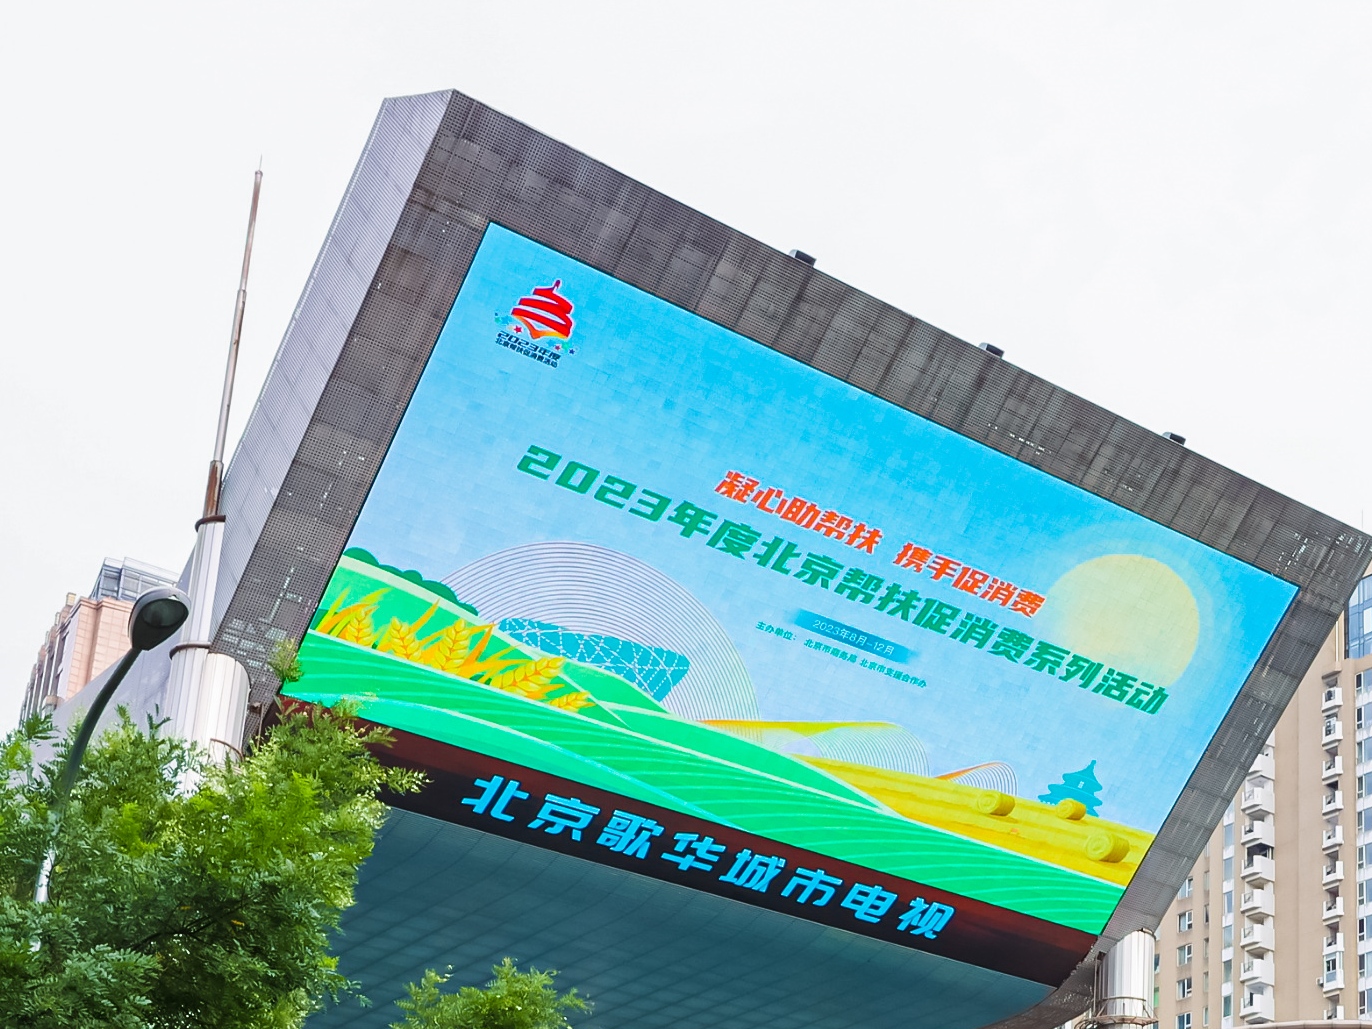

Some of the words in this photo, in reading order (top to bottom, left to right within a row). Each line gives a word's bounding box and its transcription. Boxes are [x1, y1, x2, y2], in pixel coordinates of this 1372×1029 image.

[516, 444, 1170, 715] 2023年度北京帮扶促消费系列活动
[714, 469, 884, 555] 凝心助帮扶
[892, 541, 1046, 618] 携手促消费
[460, 774, 957, 940] 北京歌华城市电视
